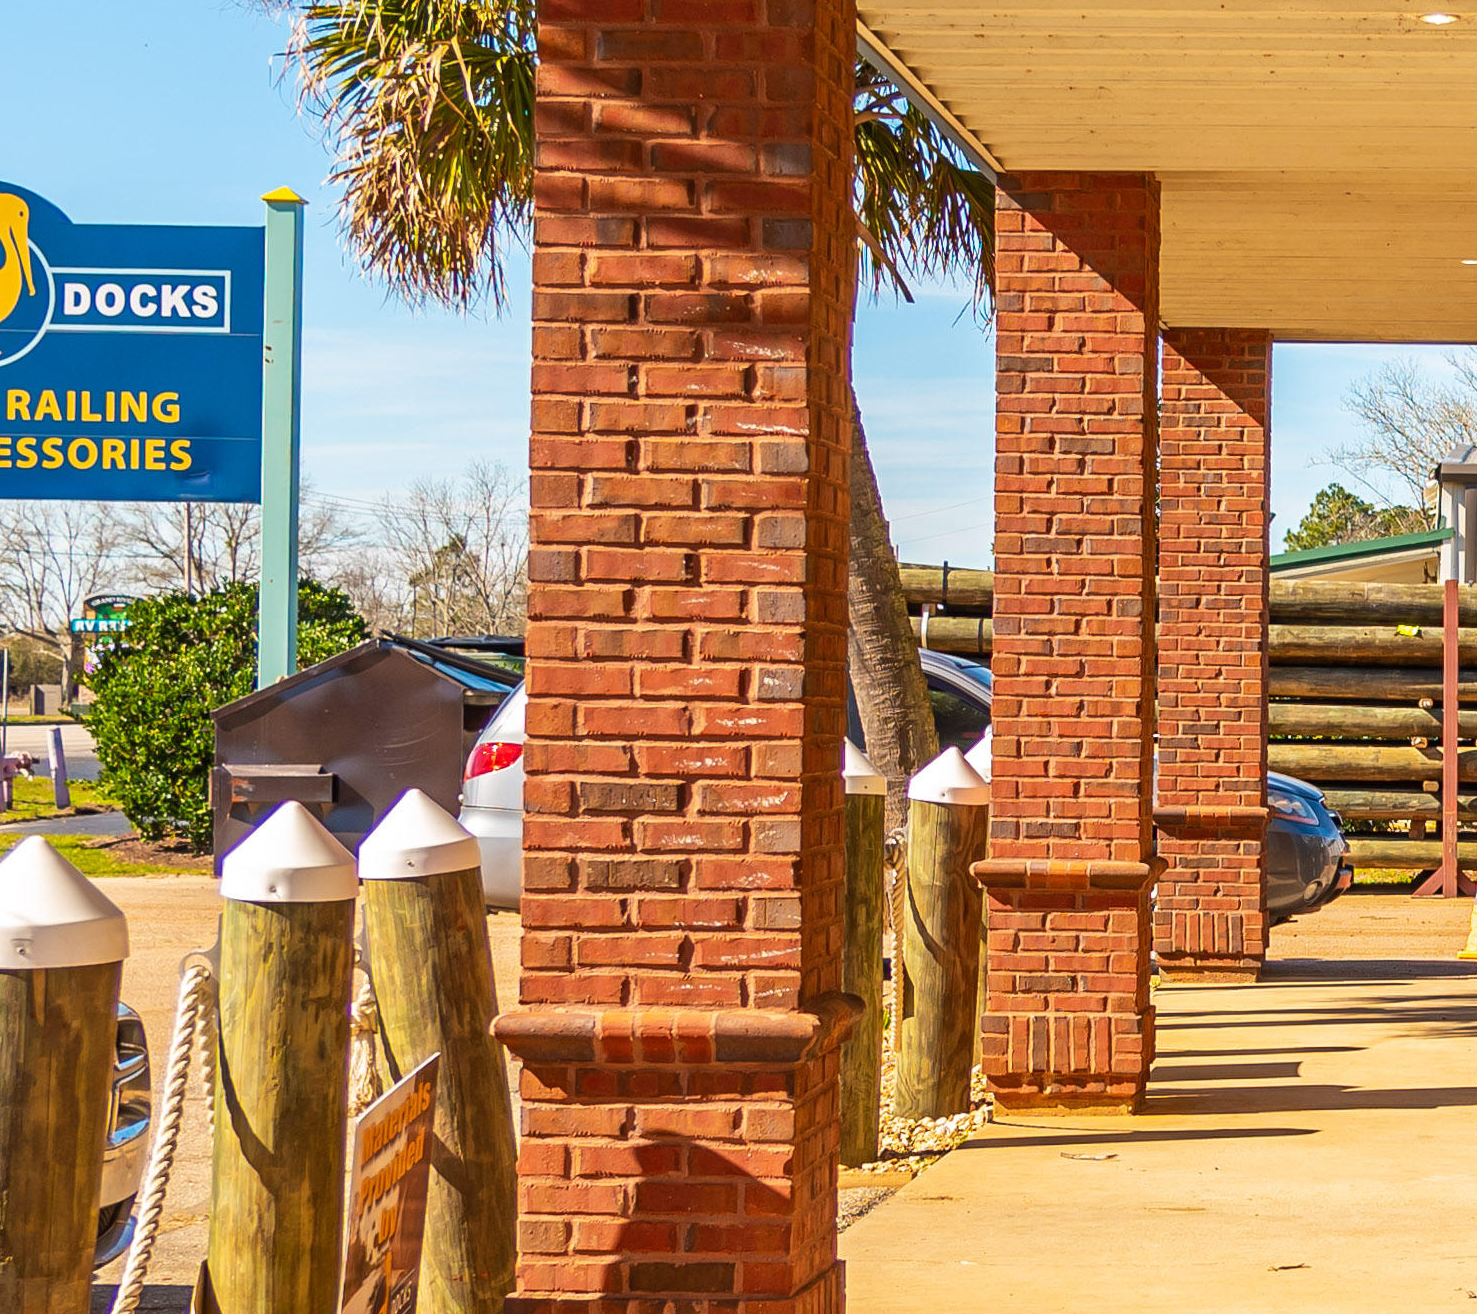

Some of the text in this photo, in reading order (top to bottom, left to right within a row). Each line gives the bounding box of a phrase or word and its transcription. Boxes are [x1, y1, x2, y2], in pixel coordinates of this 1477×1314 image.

[63, 282, 219, 318] DOCKS
[6, 389, 181, 423] RAILING
[361, 1082, 432, 1167] Materials
[358, 1126, 426, 1218] Provided
[378, 1203, 399, 1246] by
